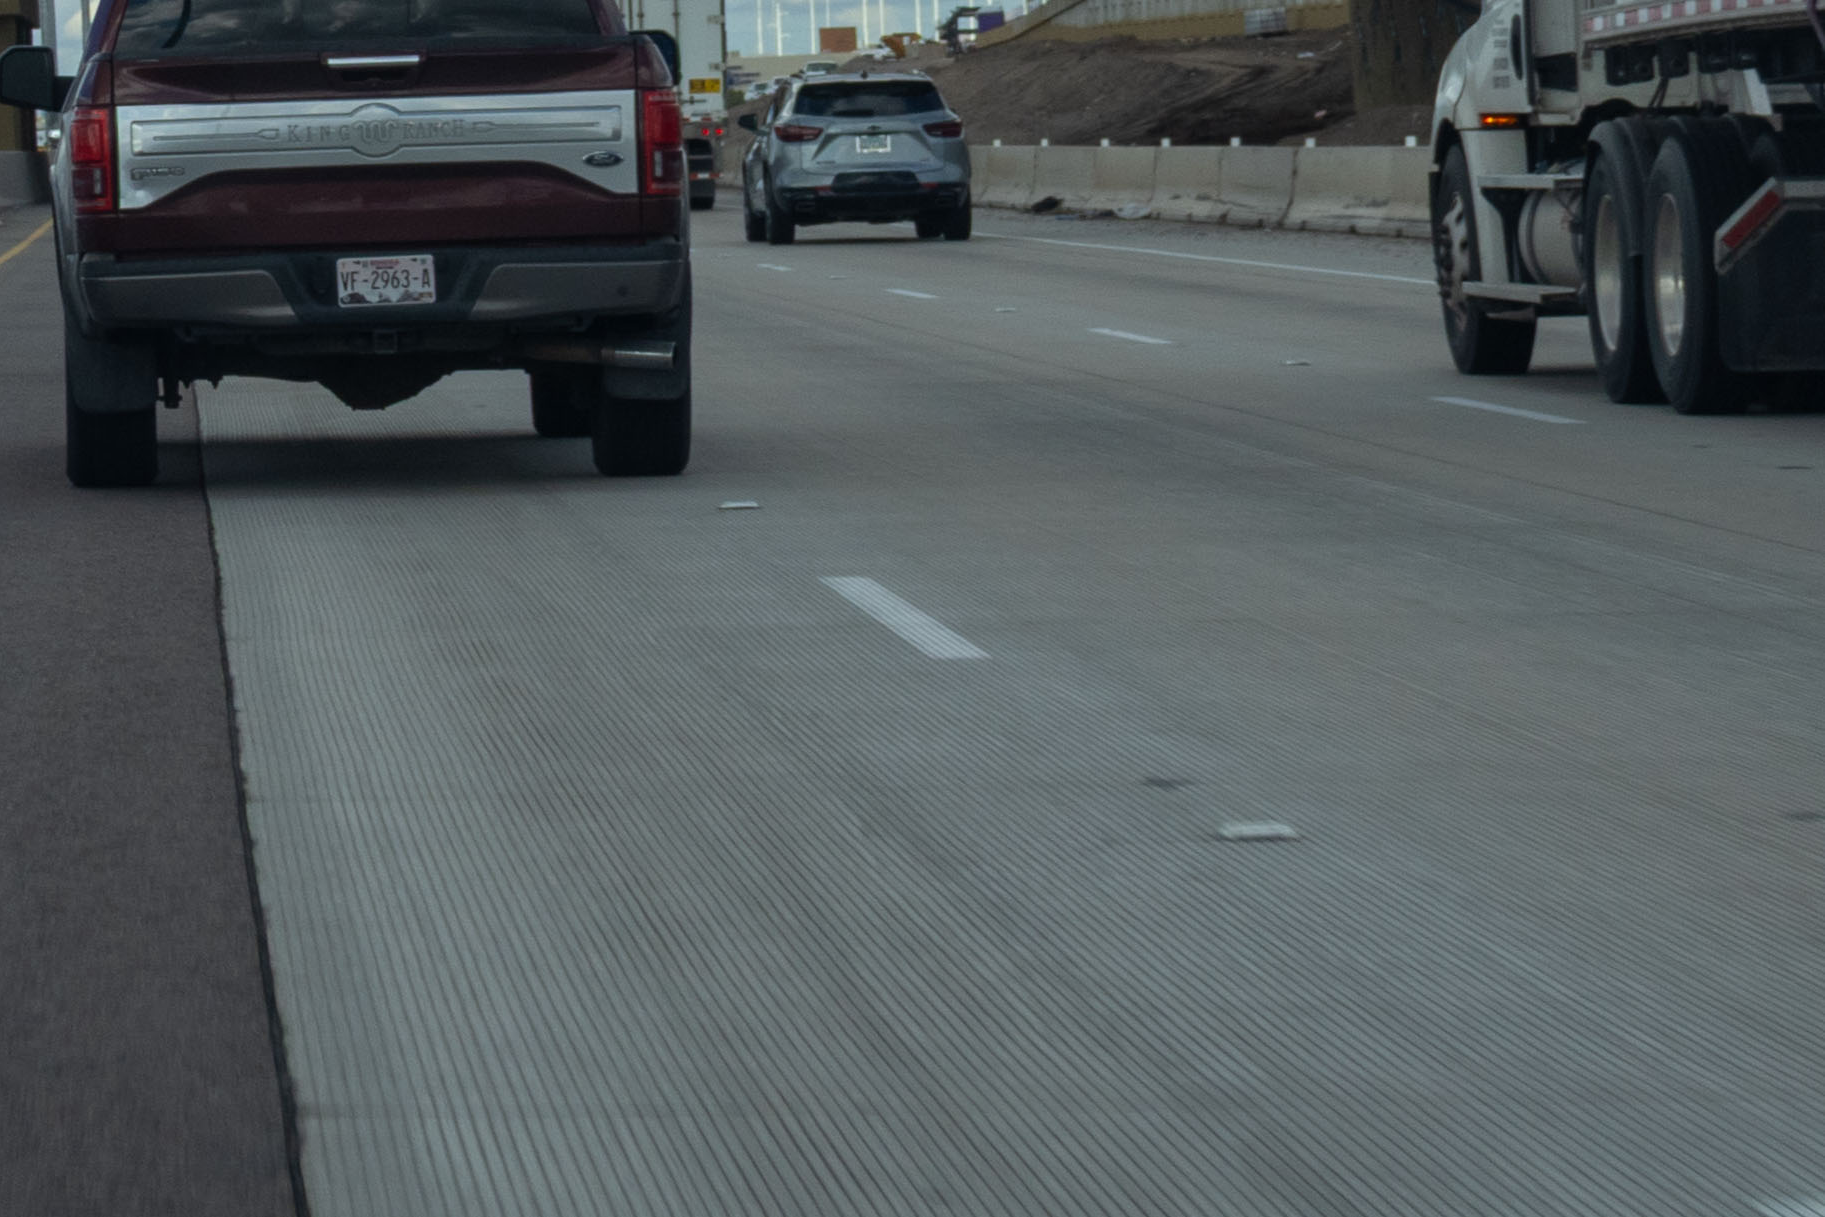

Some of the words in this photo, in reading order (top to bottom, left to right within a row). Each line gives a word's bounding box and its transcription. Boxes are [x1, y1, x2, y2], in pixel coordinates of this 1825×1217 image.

[287, 124, 350, 142] KING
[402, 119, 465, 139] RANCH
[340, 268, 431, 291] VF-2963-A
